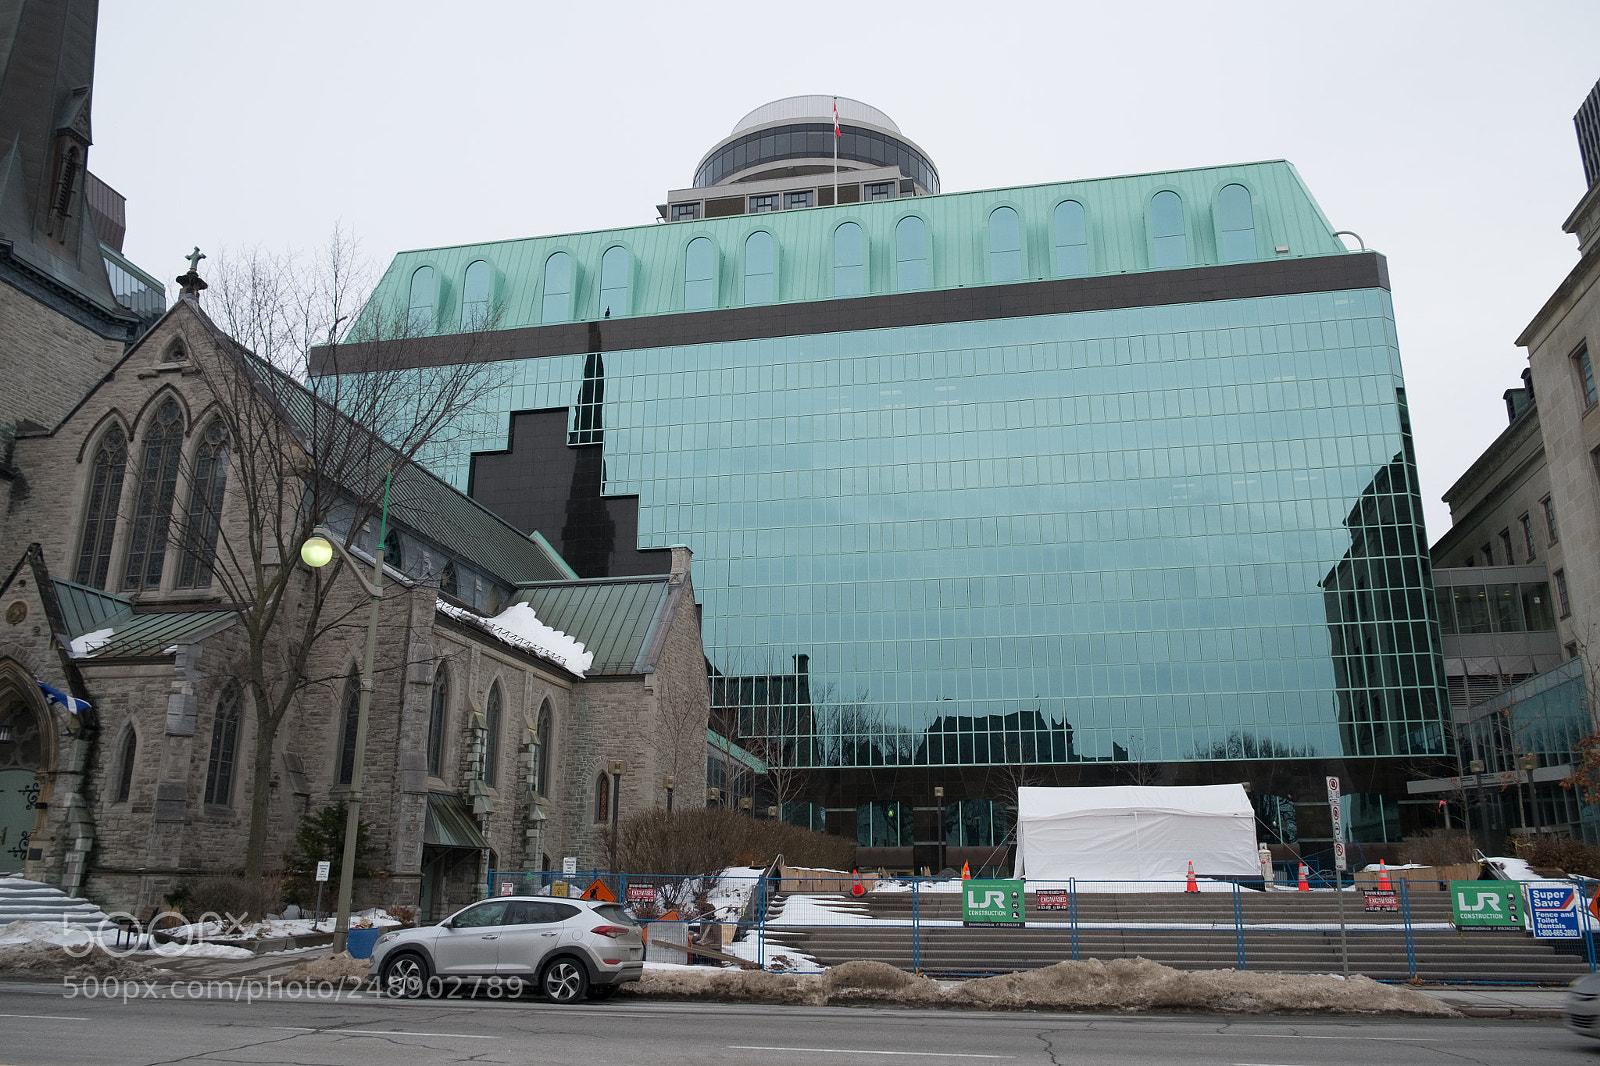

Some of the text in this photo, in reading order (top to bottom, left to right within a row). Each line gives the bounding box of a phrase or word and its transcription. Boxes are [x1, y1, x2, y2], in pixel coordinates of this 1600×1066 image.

[968, 891, 1006, 908] LJR
[1532, 890, 1565, 900] Super
[1458, 892, 1502, 911] LJR
[1533, 898, 1561, 908] Save
[1537, 922, 1567, 930] Rentals
